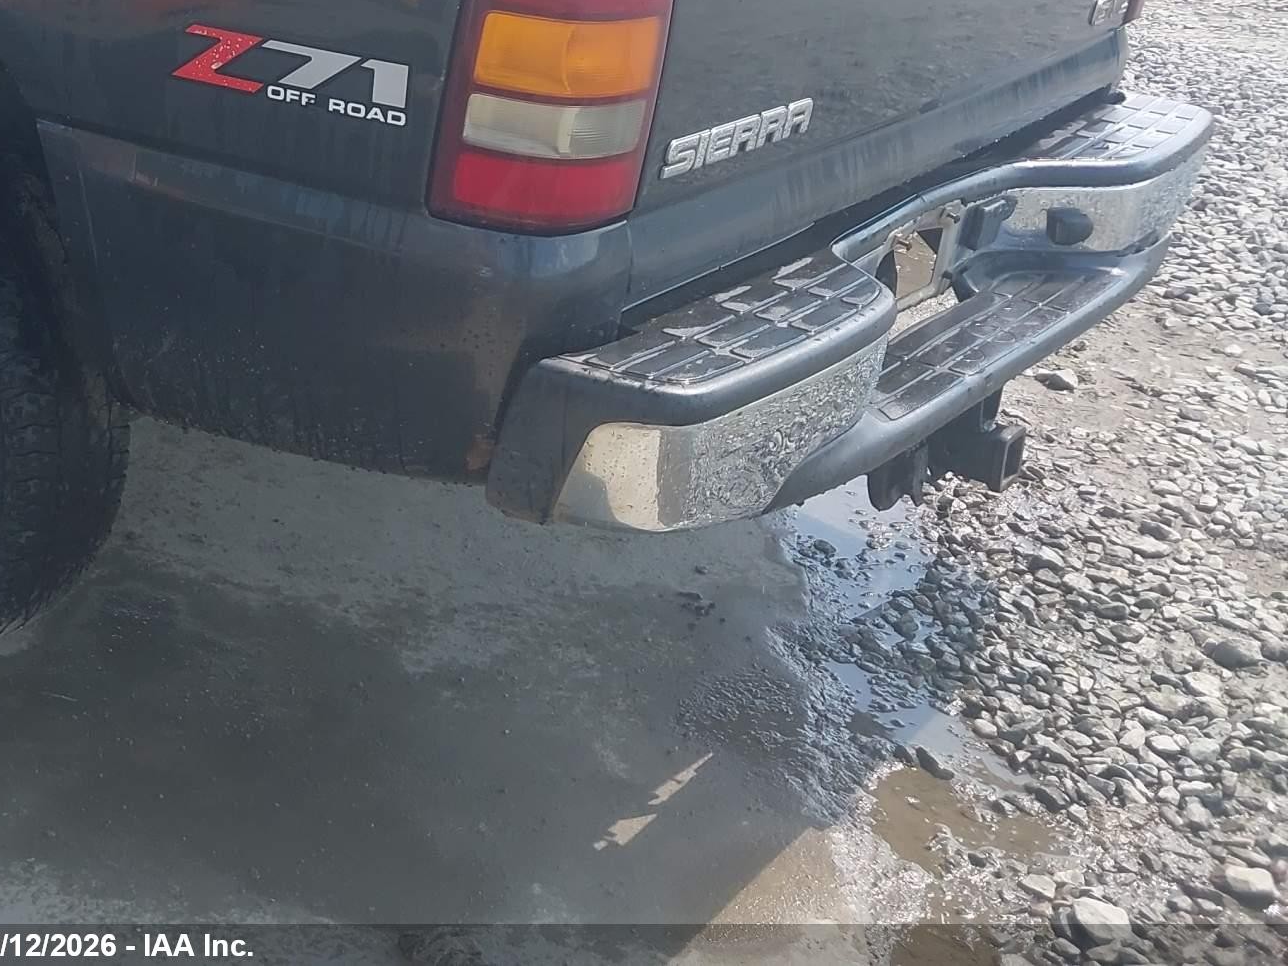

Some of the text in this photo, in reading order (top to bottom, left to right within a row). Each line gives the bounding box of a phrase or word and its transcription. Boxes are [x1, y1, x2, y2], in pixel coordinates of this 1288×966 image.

[172, 24, 409, 109] Z71
[267, 85, 407, 127] OFF ROAD
[659, 97, 814, 179] SIERRA
